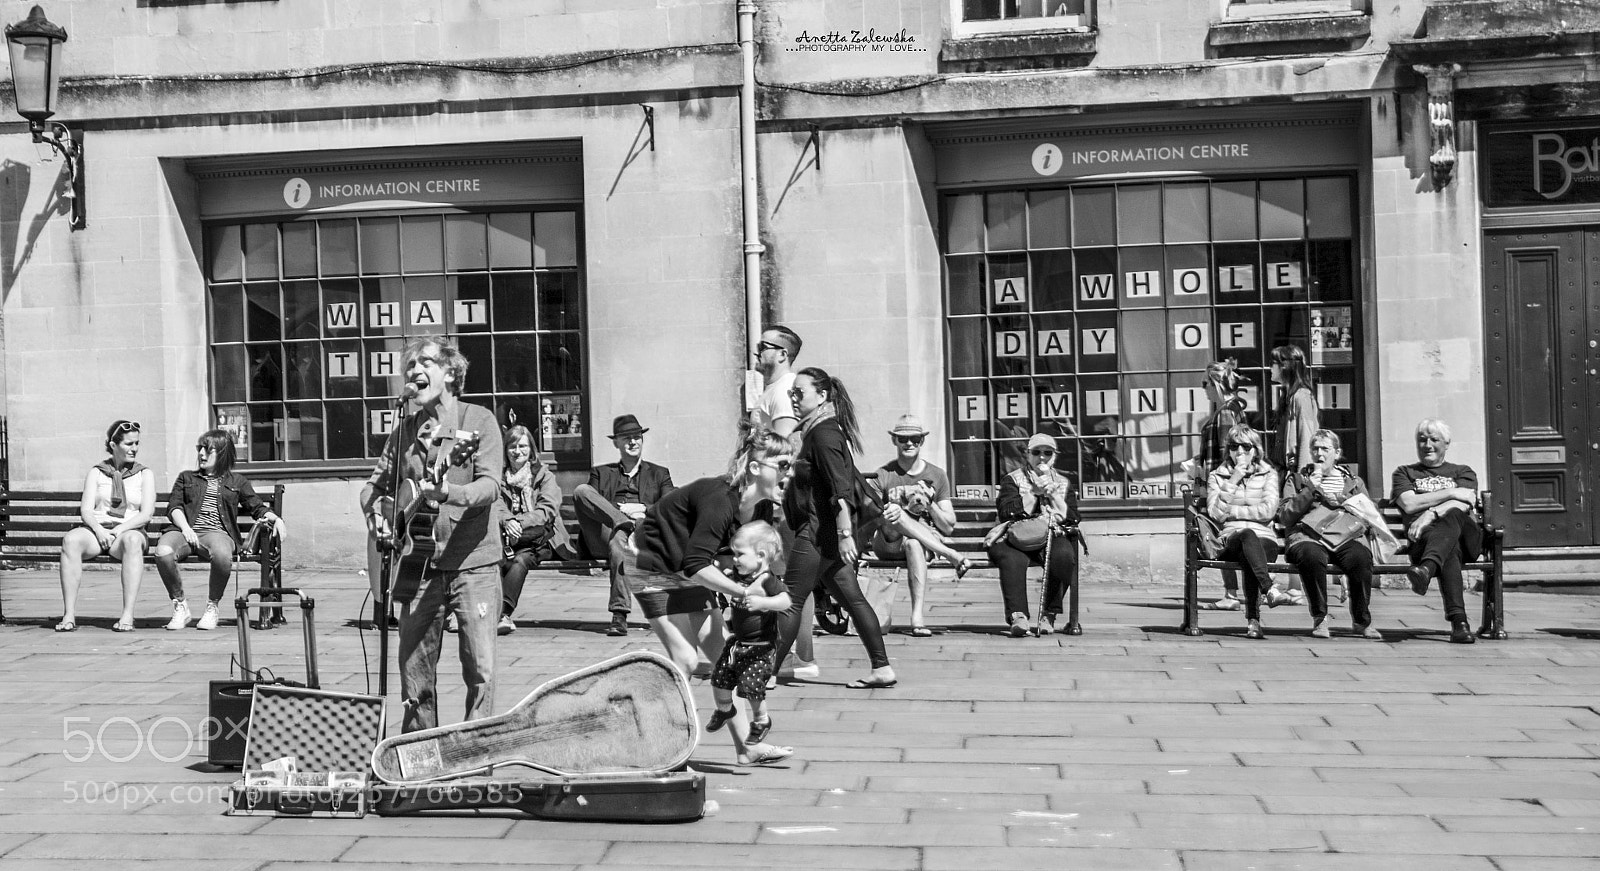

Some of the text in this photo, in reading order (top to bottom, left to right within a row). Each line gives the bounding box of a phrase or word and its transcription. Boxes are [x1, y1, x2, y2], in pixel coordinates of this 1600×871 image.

[1072, 146, 1184, 164] INFORMATION
[1190, 143, 1249, 159] CENTRE
[319, 181, 421, 198] INFORMATION
[426, 178, 480, 193] CENTRE
[1001, 263, 1292, 302] A WHOLE
[327, 300, 478, 327] WHAT
[1003, 323, 1243, 355] DAY OF
[966, 385, 1337, 419] FEMINIS!
[957, 487, 999, 500] #FRA
[1087, 485, 1117, 496] FILM
[1130, 484, 1167, 495] BATH
